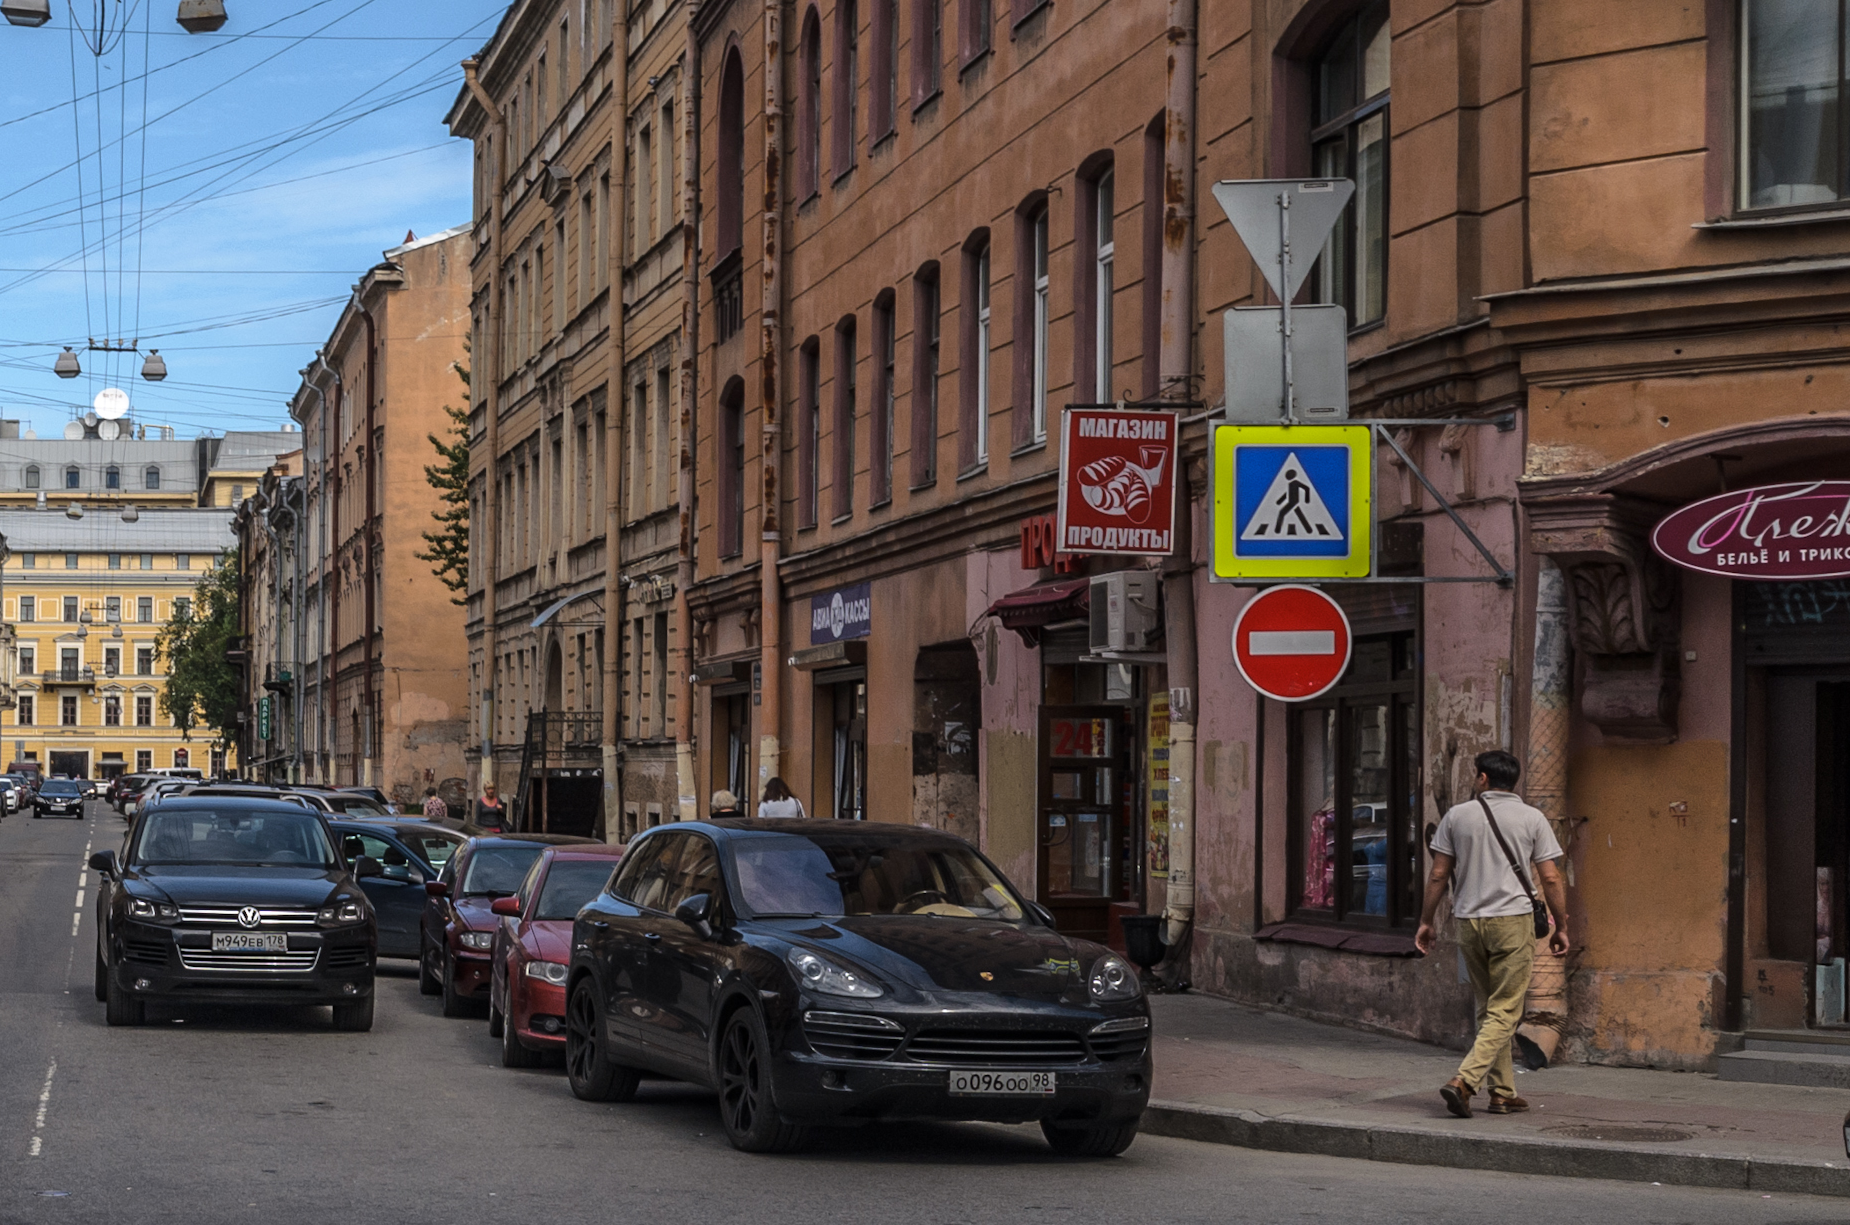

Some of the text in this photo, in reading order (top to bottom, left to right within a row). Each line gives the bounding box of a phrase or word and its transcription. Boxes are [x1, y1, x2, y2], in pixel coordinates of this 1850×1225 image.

[1079, 418, 1167, 440] МАГАЗИН
[1067, 525, 1169, 549] ПРОДУКТЫ
[1717, 549, 1768, 566] БЕЛЬЁ
[1778, 550, 1790, 563] И
[812, 606, 831, 631] АВИА
[844, 597, 870, 624] КАССЫ
[1055, 721, 1093, 755] 24
[1033, 1074, 1049, 1087] 98
